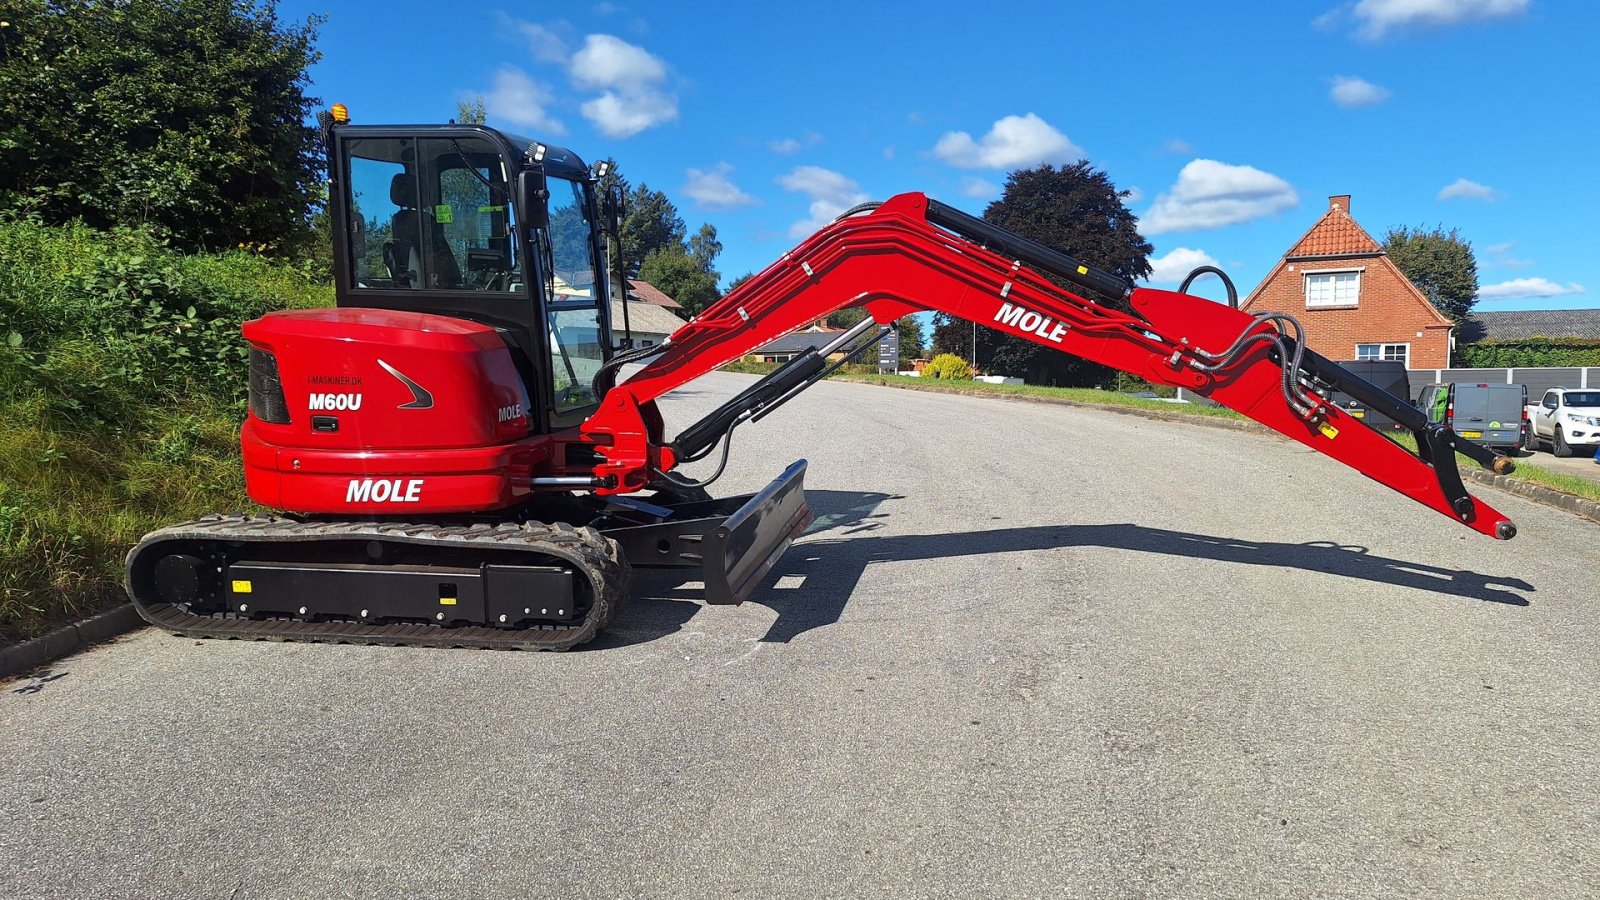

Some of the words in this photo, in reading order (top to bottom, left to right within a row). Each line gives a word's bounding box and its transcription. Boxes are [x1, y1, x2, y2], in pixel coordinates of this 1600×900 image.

[993, 302, 1072, 343] MOLE
[308, 393, 362, 411] M60U
[498, 403, 521, 423] MOLE
[345, 479, 424, 503] MOLE
